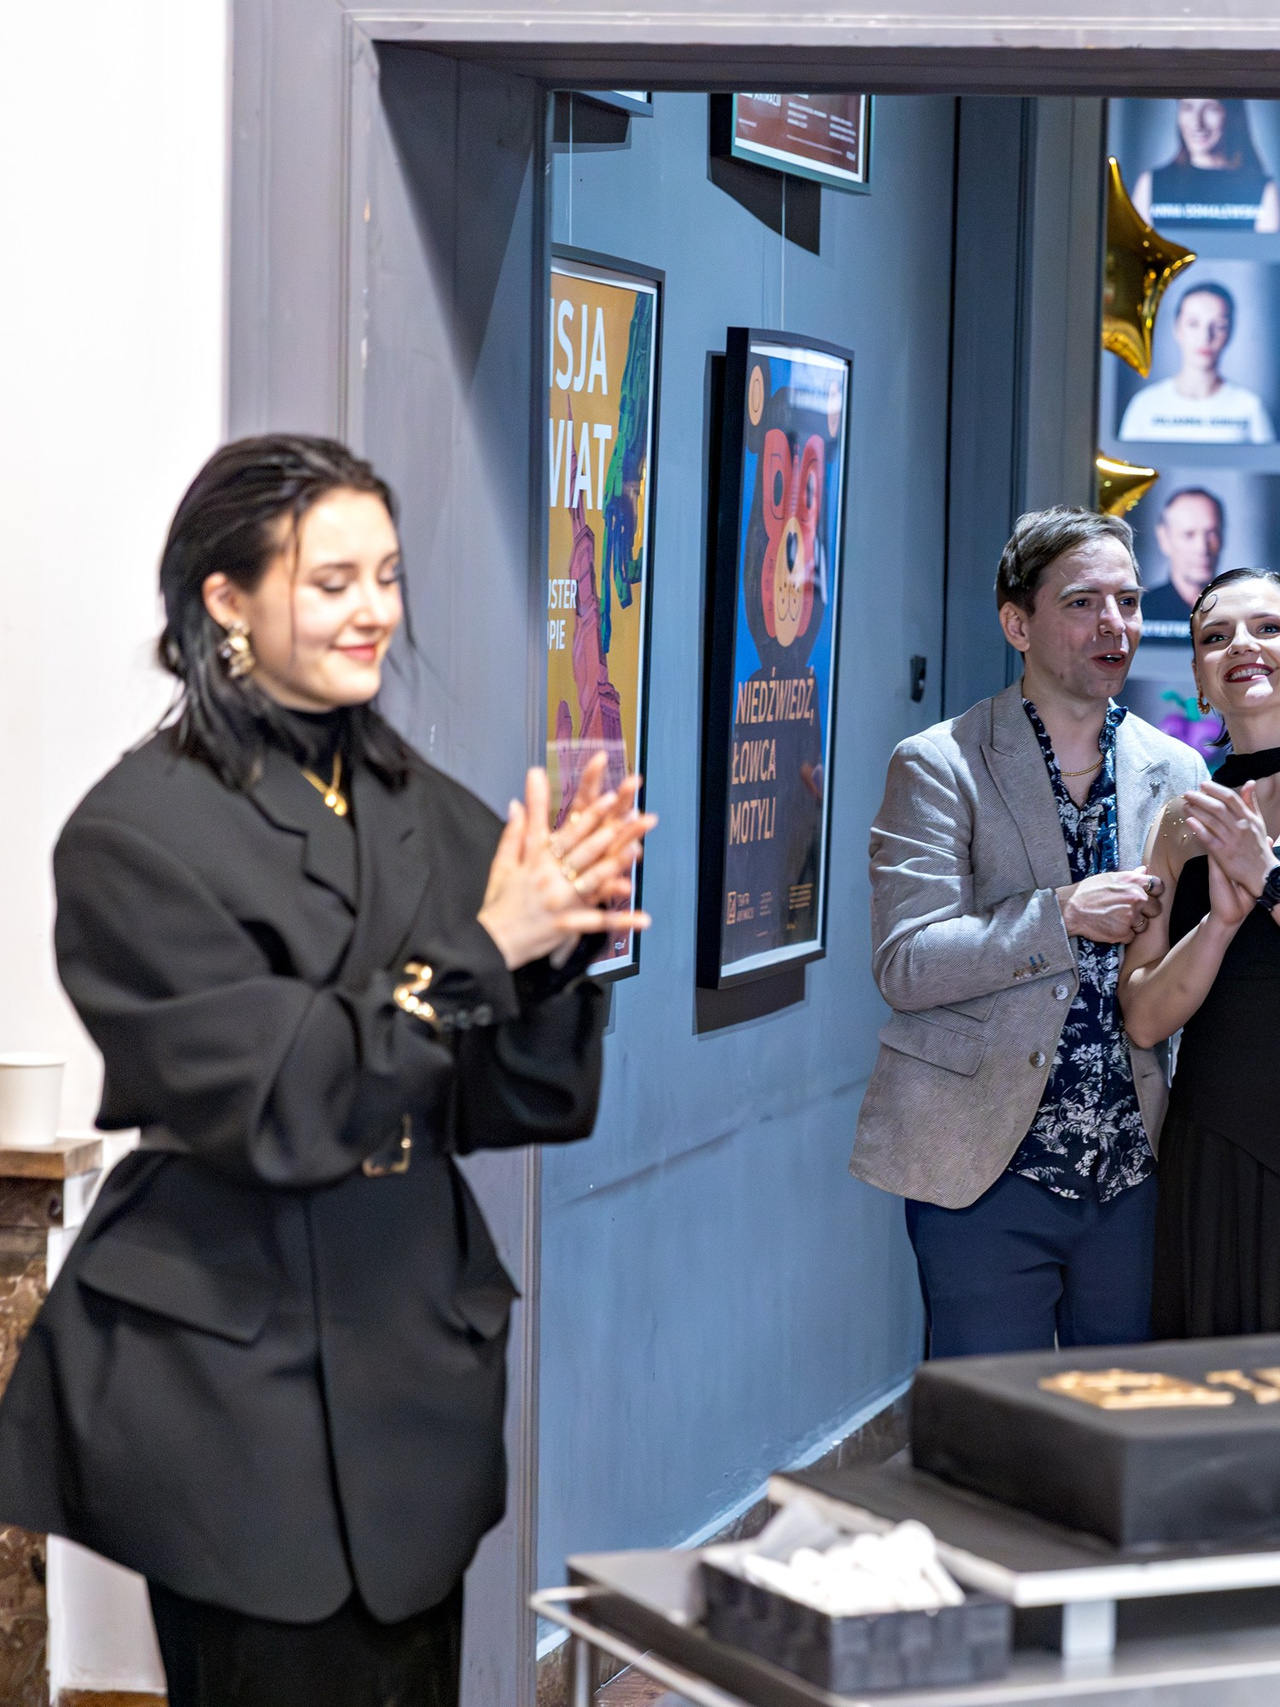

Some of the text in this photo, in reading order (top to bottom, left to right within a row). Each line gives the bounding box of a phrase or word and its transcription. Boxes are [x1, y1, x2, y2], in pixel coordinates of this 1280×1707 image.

[735, 665, 815, 726] NIEDŹWIEDŹ,
[732, 738, 776, 785] ŁOWCA
[729, 797, 776, 845] MOTYLI
